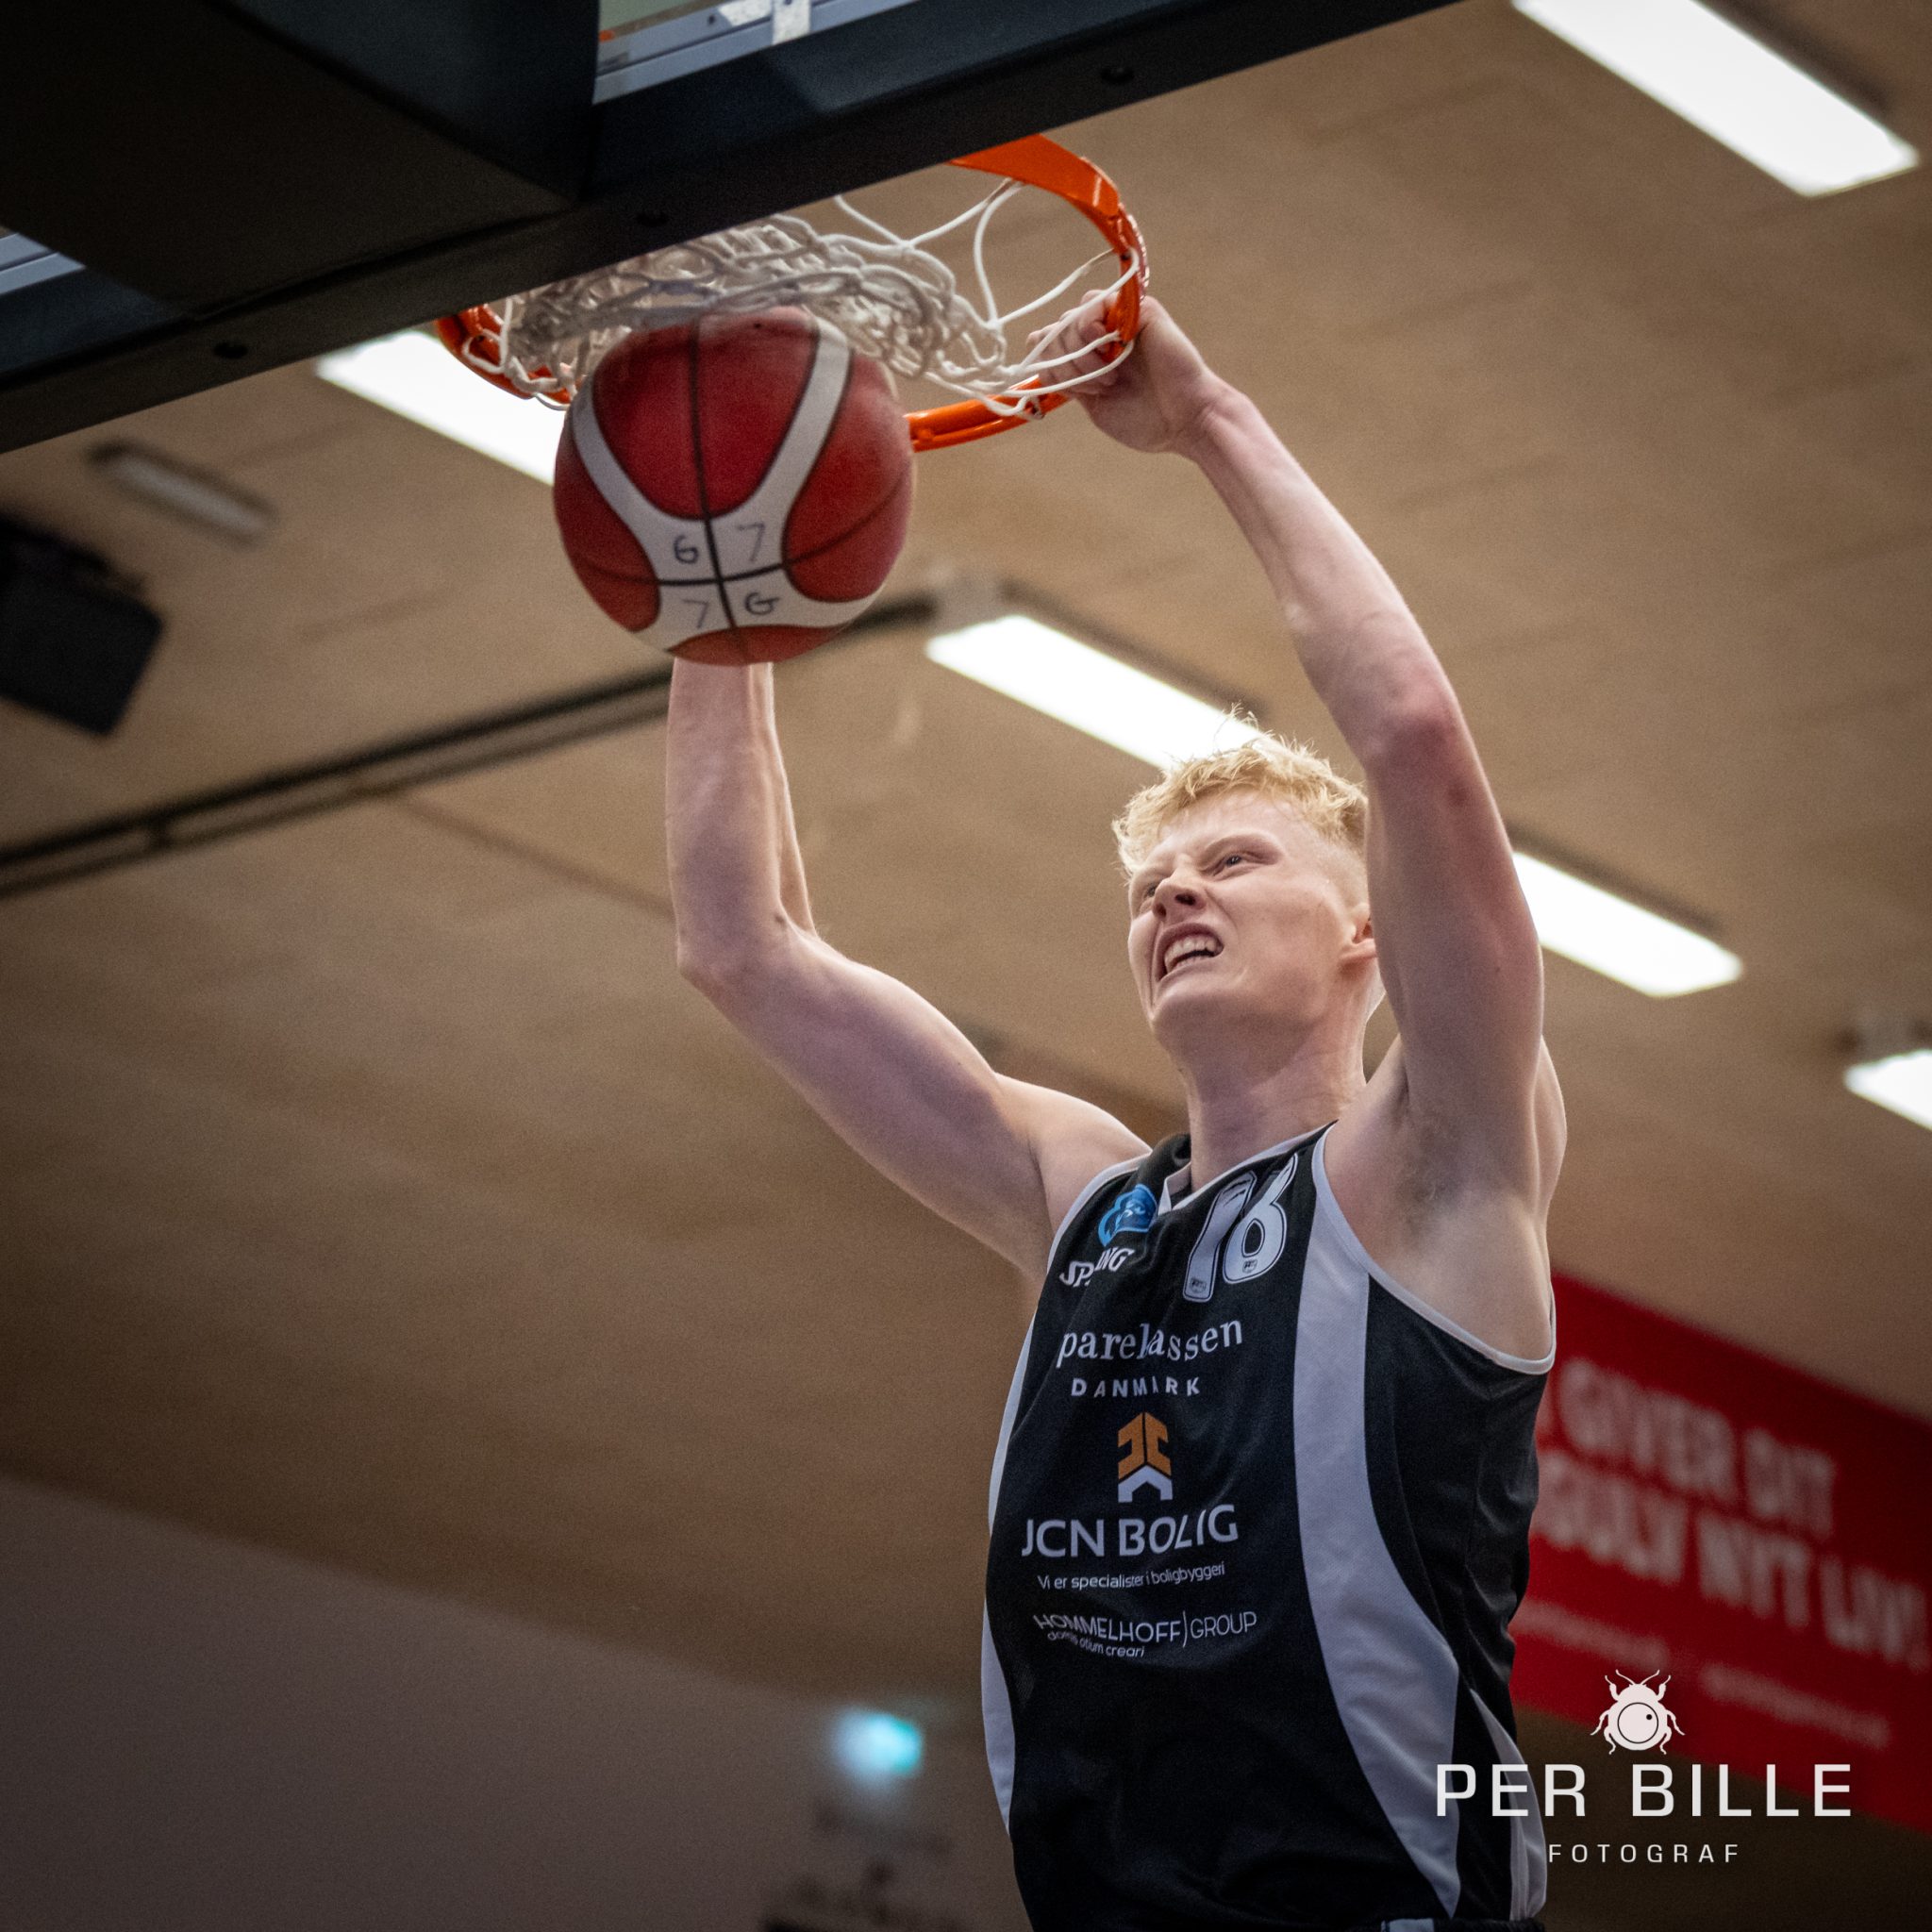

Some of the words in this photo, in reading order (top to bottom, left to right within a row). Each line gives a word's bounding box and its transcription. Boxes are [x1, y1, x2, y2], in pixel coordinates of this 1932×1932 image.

[738, 523, 765, 561] 7
[1022, 1518, 1105, 1557] JCN
[1118, 1504, 1239, 1556] BOLIG
[1038, 1574, 1051, 1590] Vi
[1054, 1577, 1067, 1589] er
